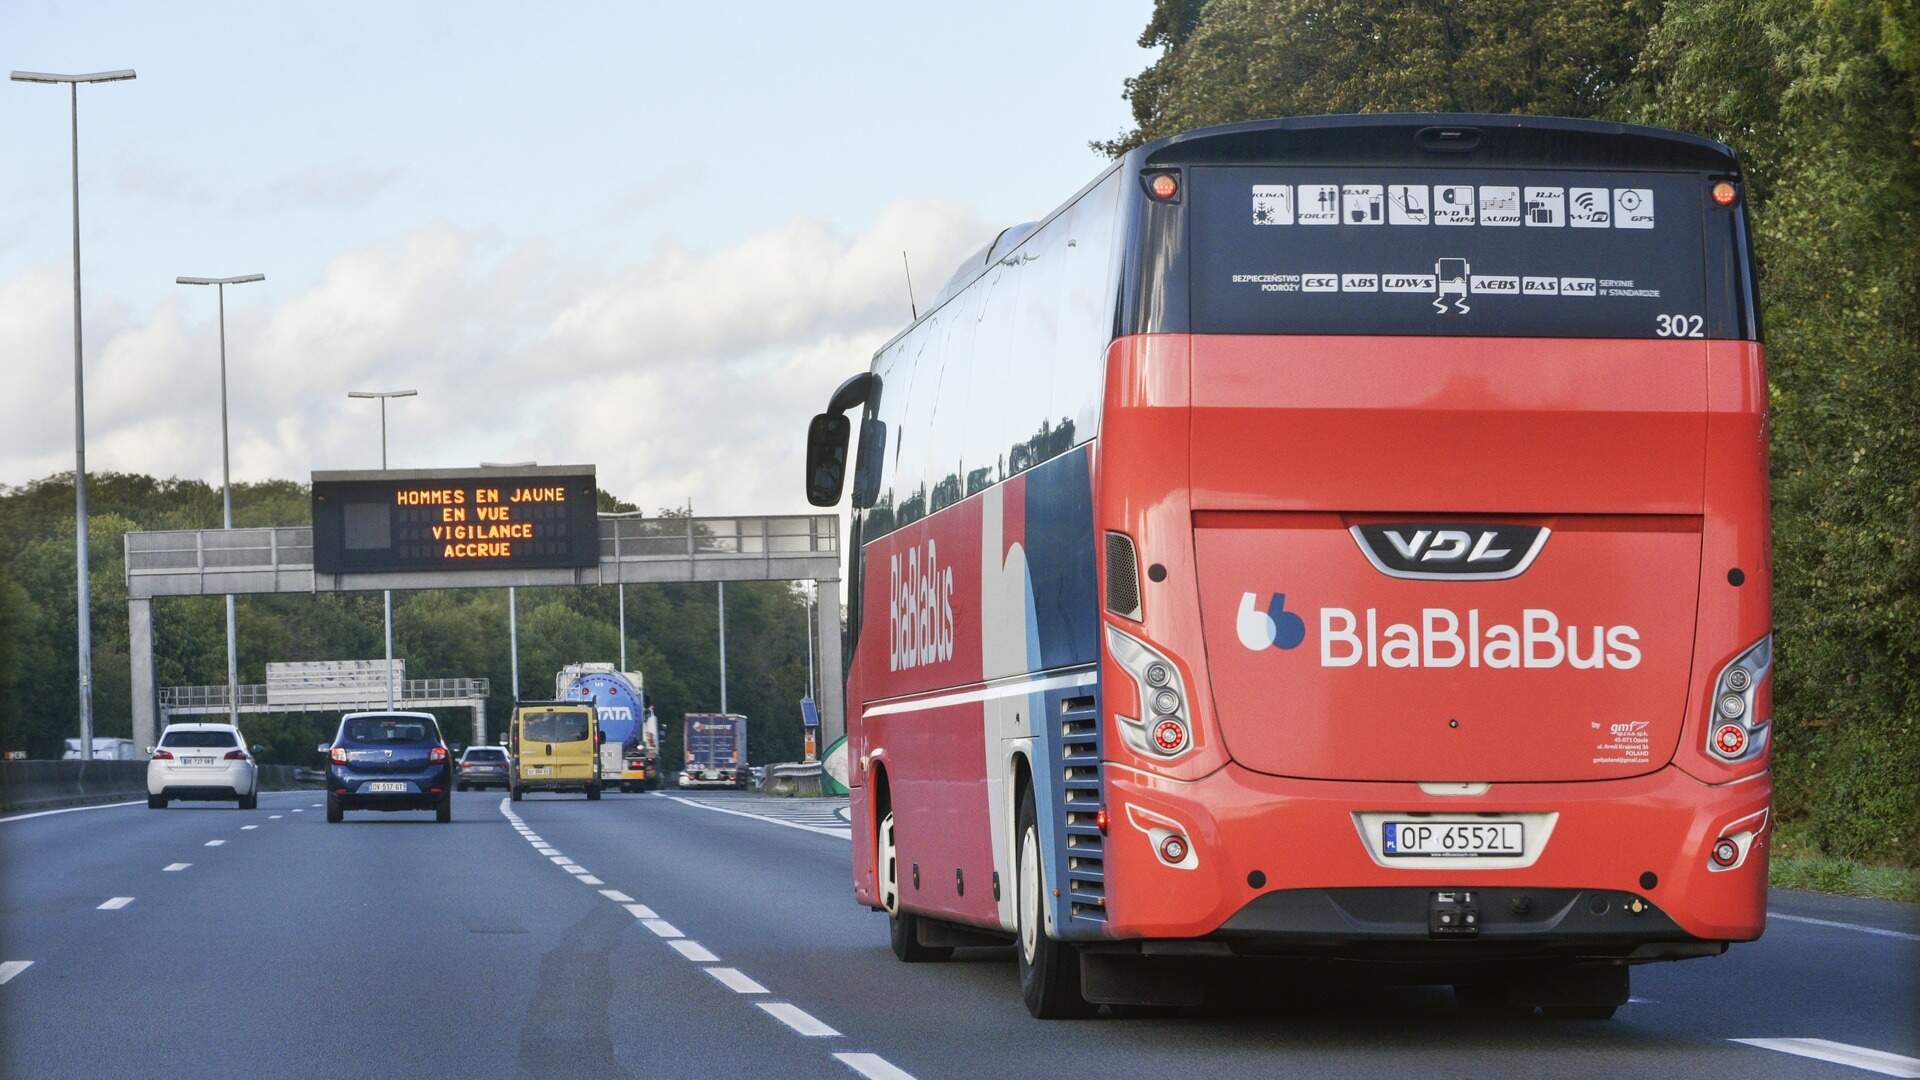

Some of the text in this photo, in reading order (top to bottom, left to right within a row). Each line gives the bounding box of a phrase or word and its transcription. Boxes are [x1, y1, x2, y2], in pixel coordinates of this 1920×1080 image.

[1304, 278, 1337, 288] ESC
[1344, 278, 1376, 288] ABS
[1384, 278, 1434, 289] LDWS
[1473, 280, 1517, 290] AEBS
[1524, 280, 1556, 291] BAS
[1562, 281, 1595, 292] ASR
[1655, 313, 1704, 337] 302
[397, 487, 565, 505] HOMMES EN JAUNE
[442, 506, 510, 522] EN VUE
[432, 523, 533, 540] VIGILANCE
[444, 542, 511, 558] ACCRUE
[1382, 530, 1513, 563] VDL
[890, 538, 954, 673] BlaBlaBus
[1319, 607, 1642, 670] BlaBlaBus
[596, 706, 633, 721] TATA
[1386, 826, 1514, 850] PL OP 6552L
